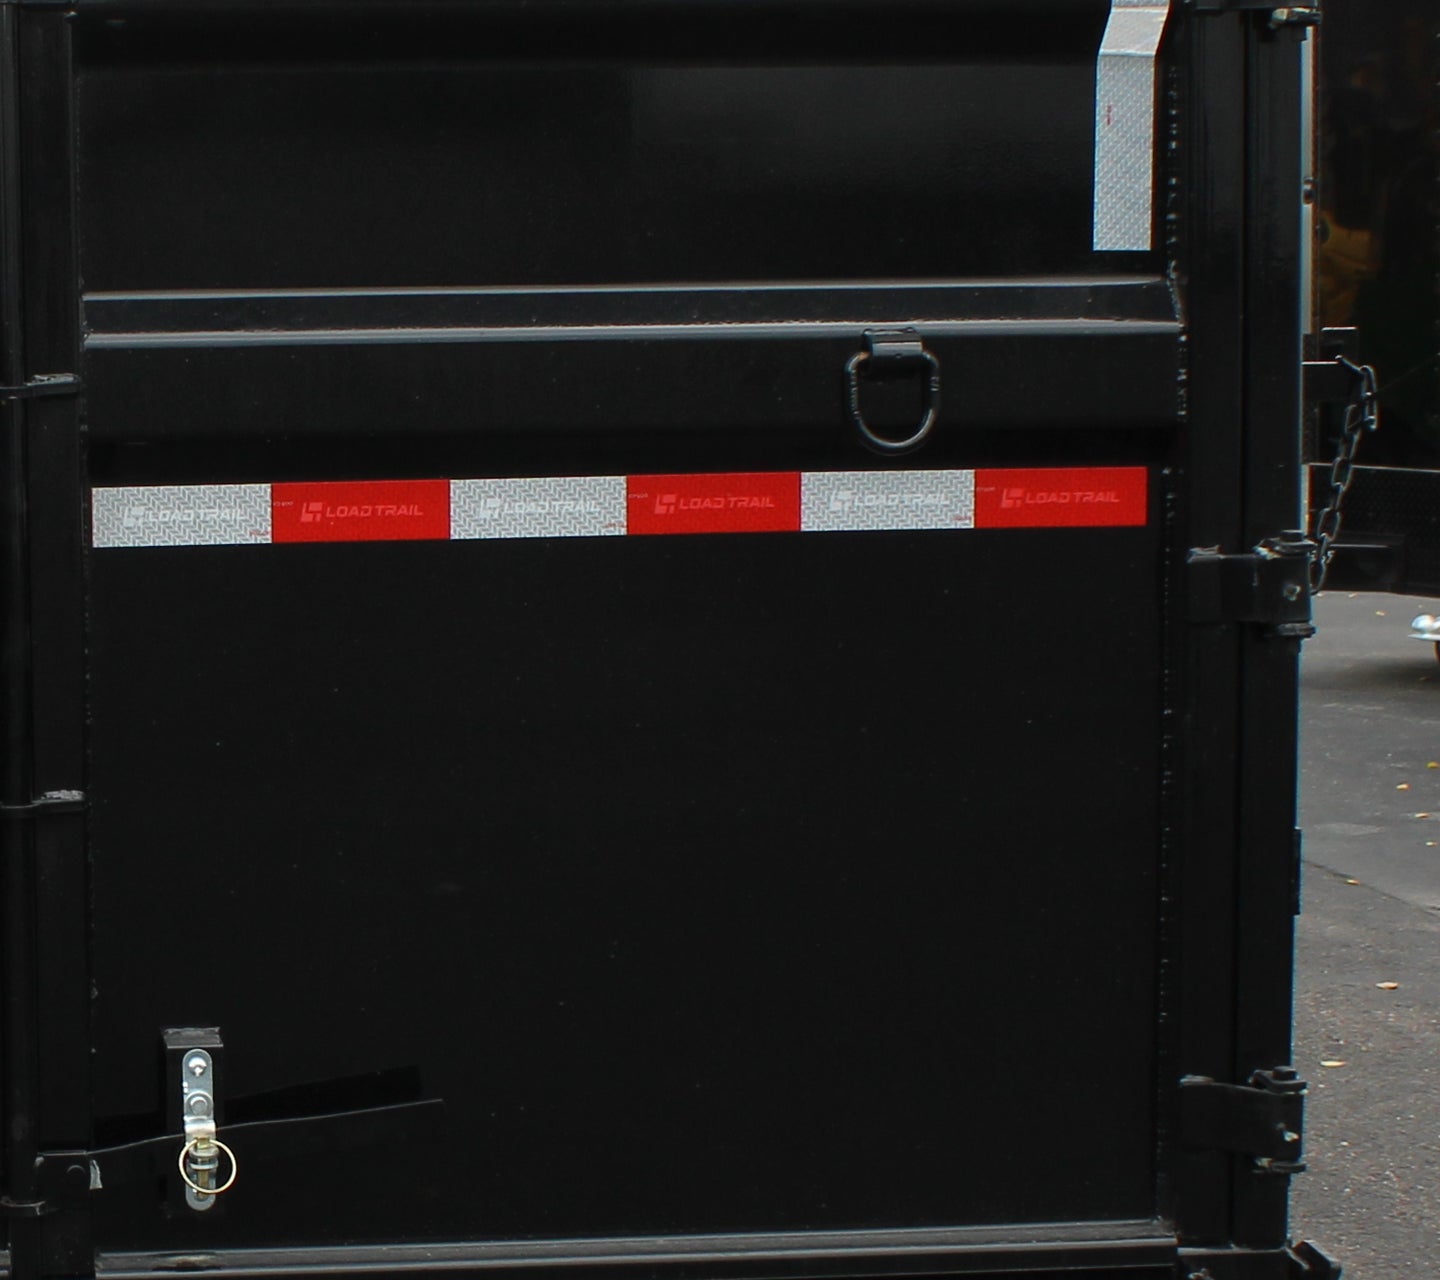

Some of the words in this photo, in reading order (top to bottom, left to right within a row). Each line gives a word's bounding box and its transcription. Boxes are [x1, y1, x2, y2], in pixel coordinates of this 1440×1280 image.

[680, 498, 725, 509] LOAD
[728, 496, 774, 507] TRAIL
[326, 506, 371, 517] LOAD
[376, 504, 423, 516] TRAIL
